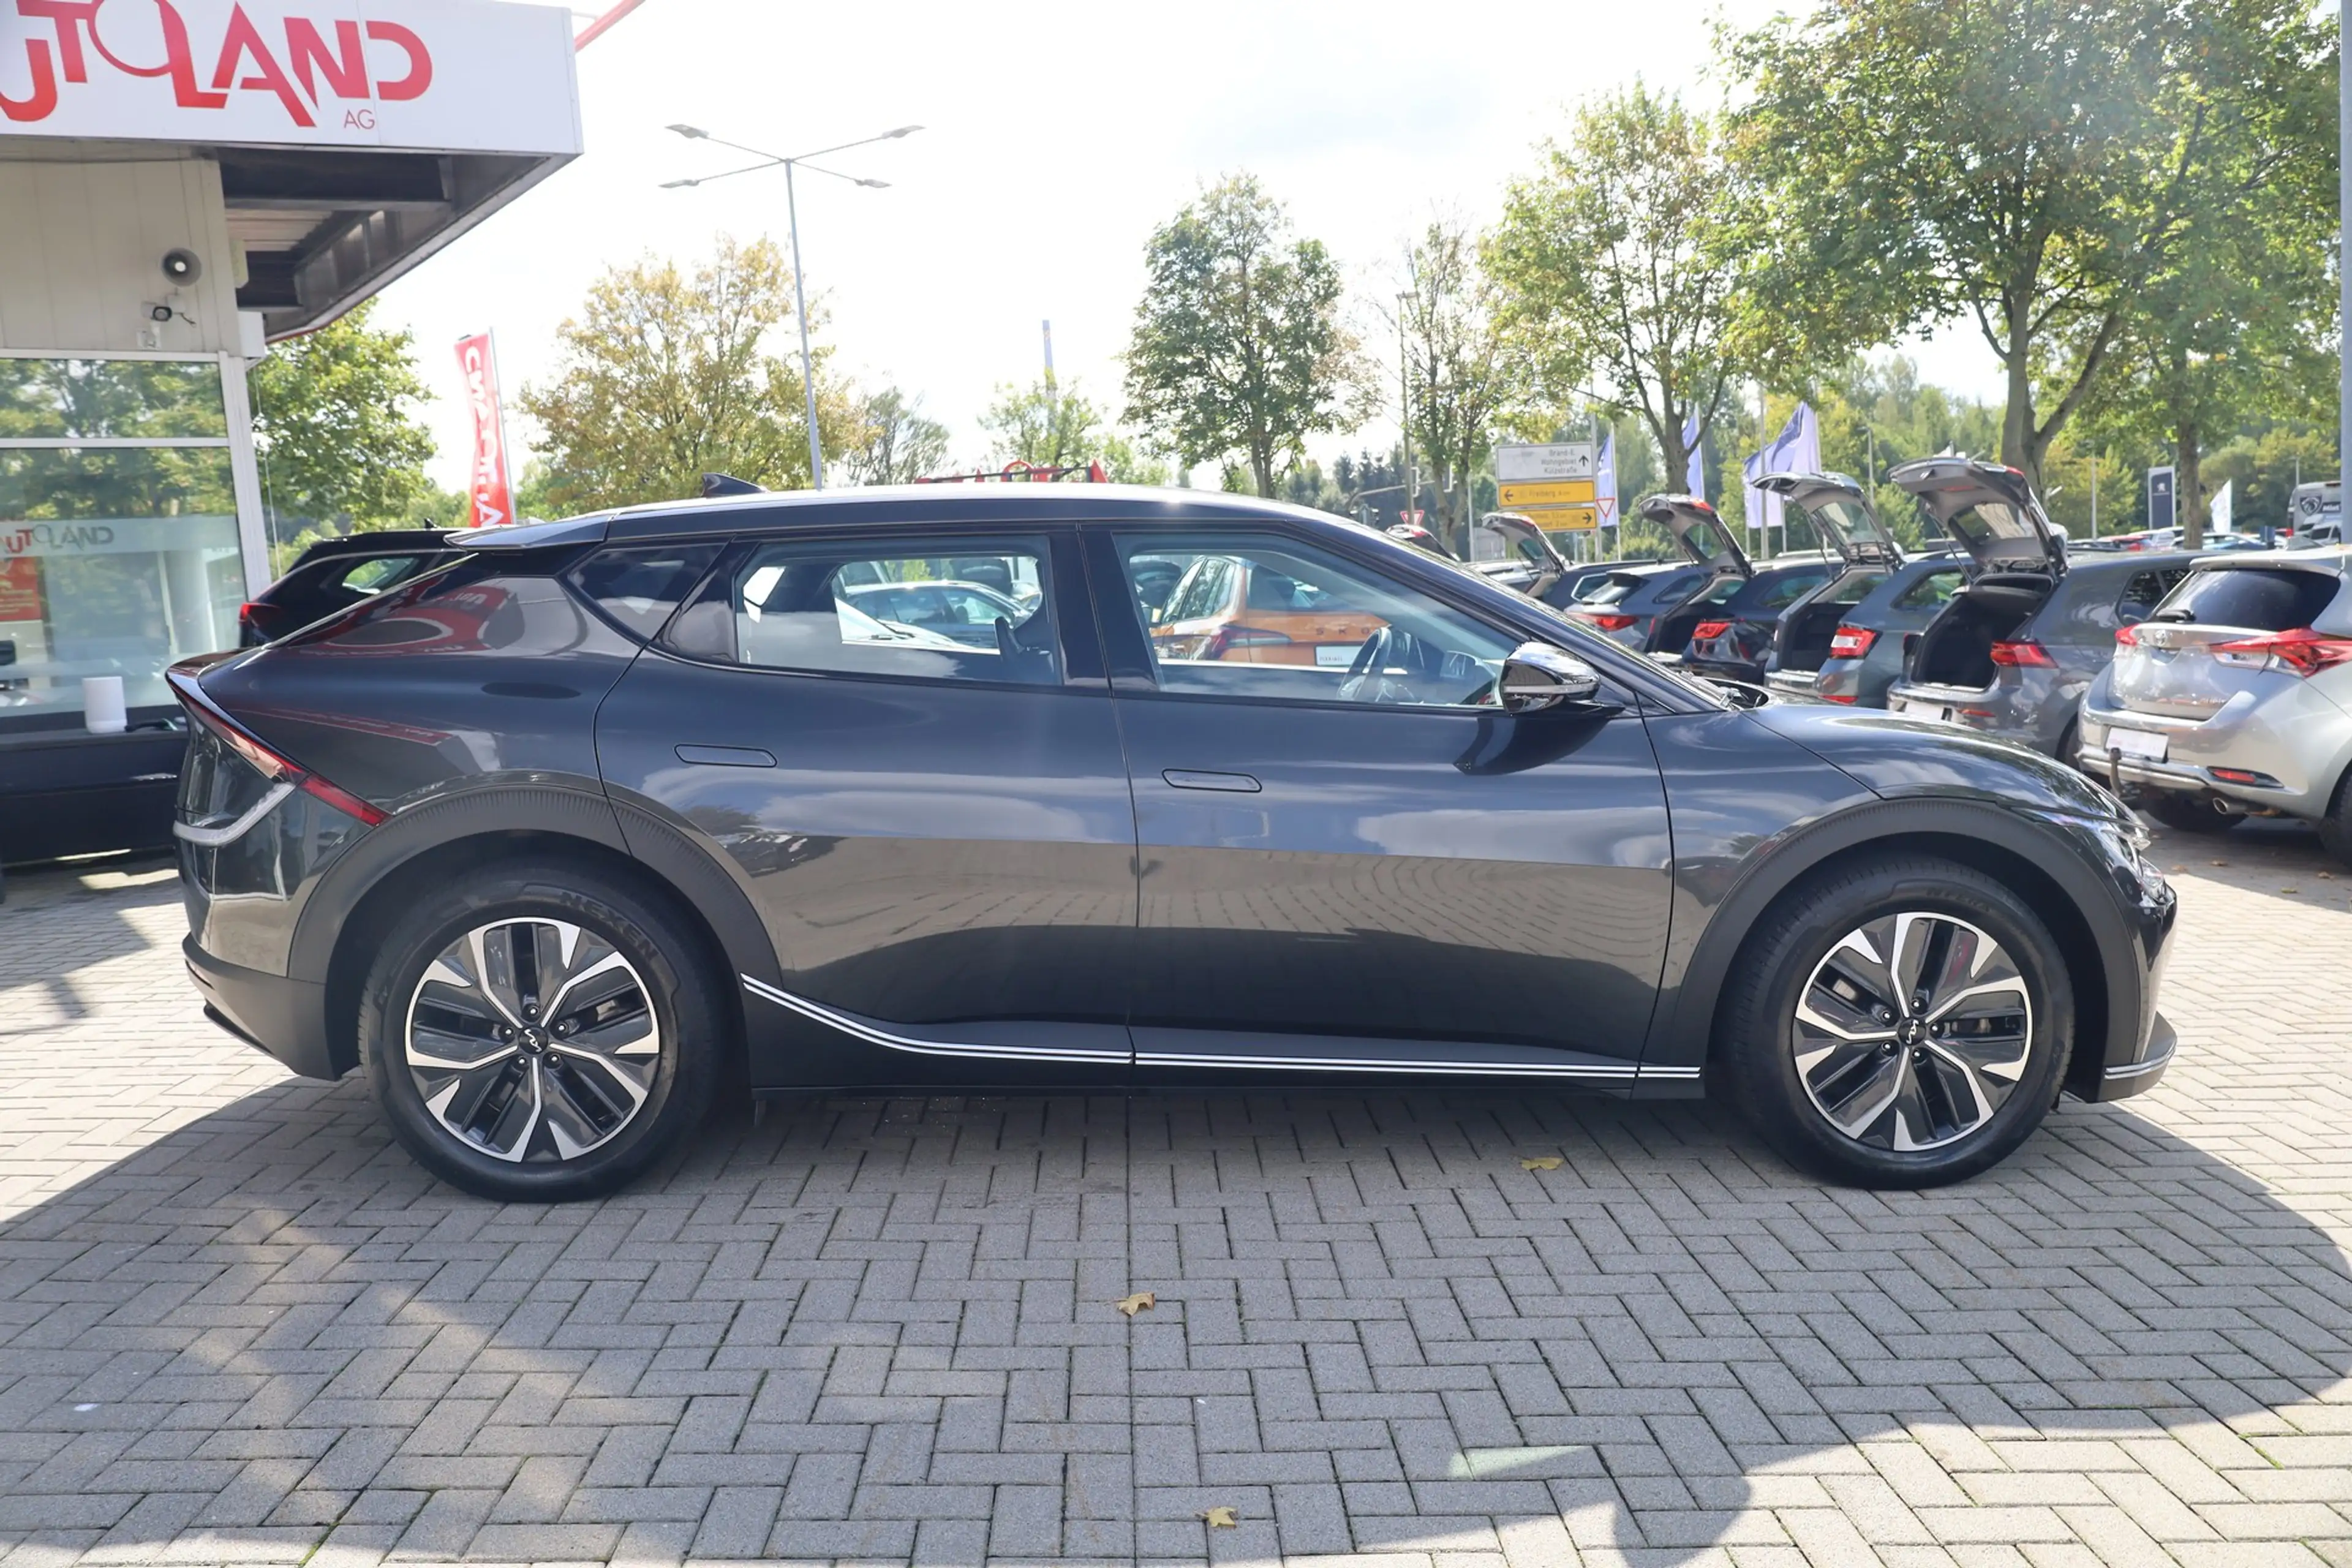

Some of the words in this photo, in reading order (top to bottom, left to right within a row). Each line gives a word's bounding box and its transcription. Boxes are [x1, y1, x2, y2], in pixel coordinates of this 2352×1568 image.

[0, 0, 432, 127] UTOLAND
[344, 108, 375, 129] AG
[560, 891, 659, 960] NEXEN
